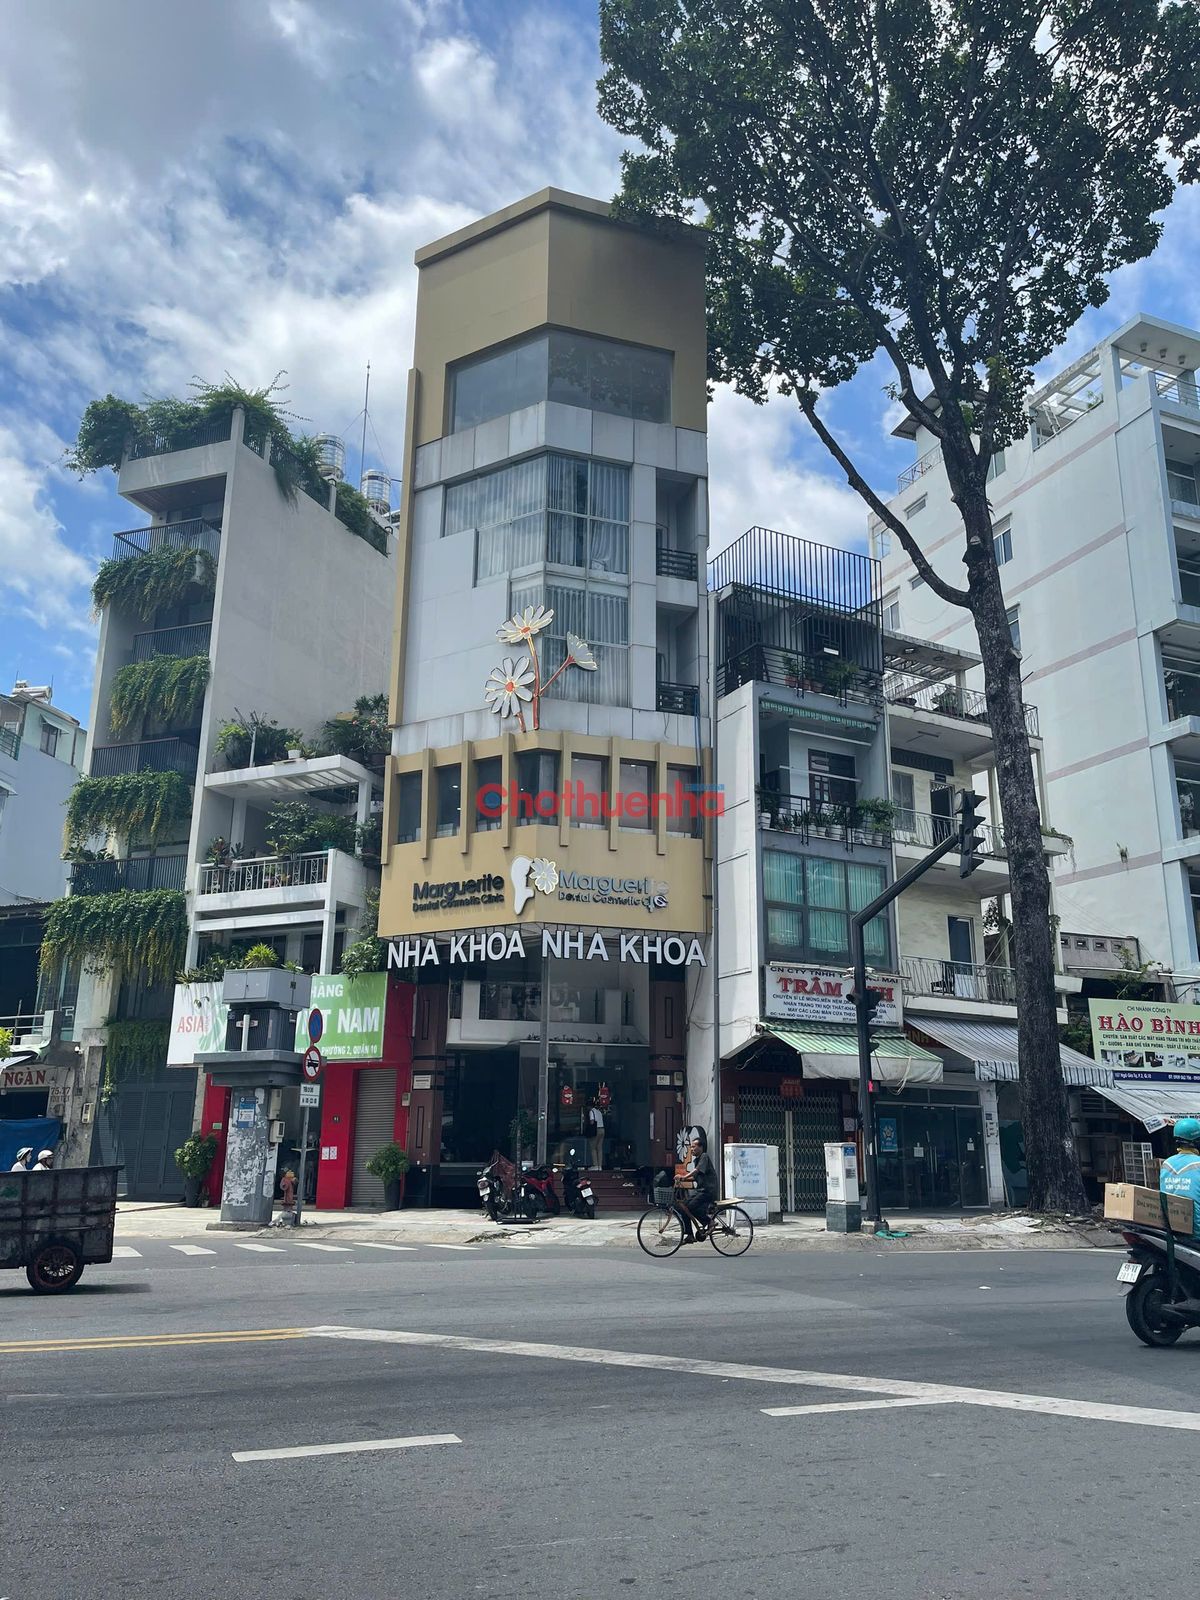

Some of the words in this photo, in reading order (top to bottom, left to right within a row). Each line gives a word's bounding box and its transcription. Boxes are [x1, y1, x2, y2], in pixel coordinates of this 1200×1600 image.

[413, 873, 505, 901] Marguerite
[558, 891, 590, 903] Dental
[413, 900, 440, 912] Dental
[440, 895, 481, 909] Cosmetic
[481, 893, 505, 905] Clinic
[387, 938, 440, 968] NHA
[450, 930, 526, 964] KHOA
[541, 930, 609, 961] NHA
[619, 933, 708, 967] KHOA
[177, 1015, 204, 1033] ASIA
[337, 1007, 380, 1034] NAM
[1097, 1013, 1144, 1032] HÀO
[1150, 1016, 1200, 1036] BÌNH
